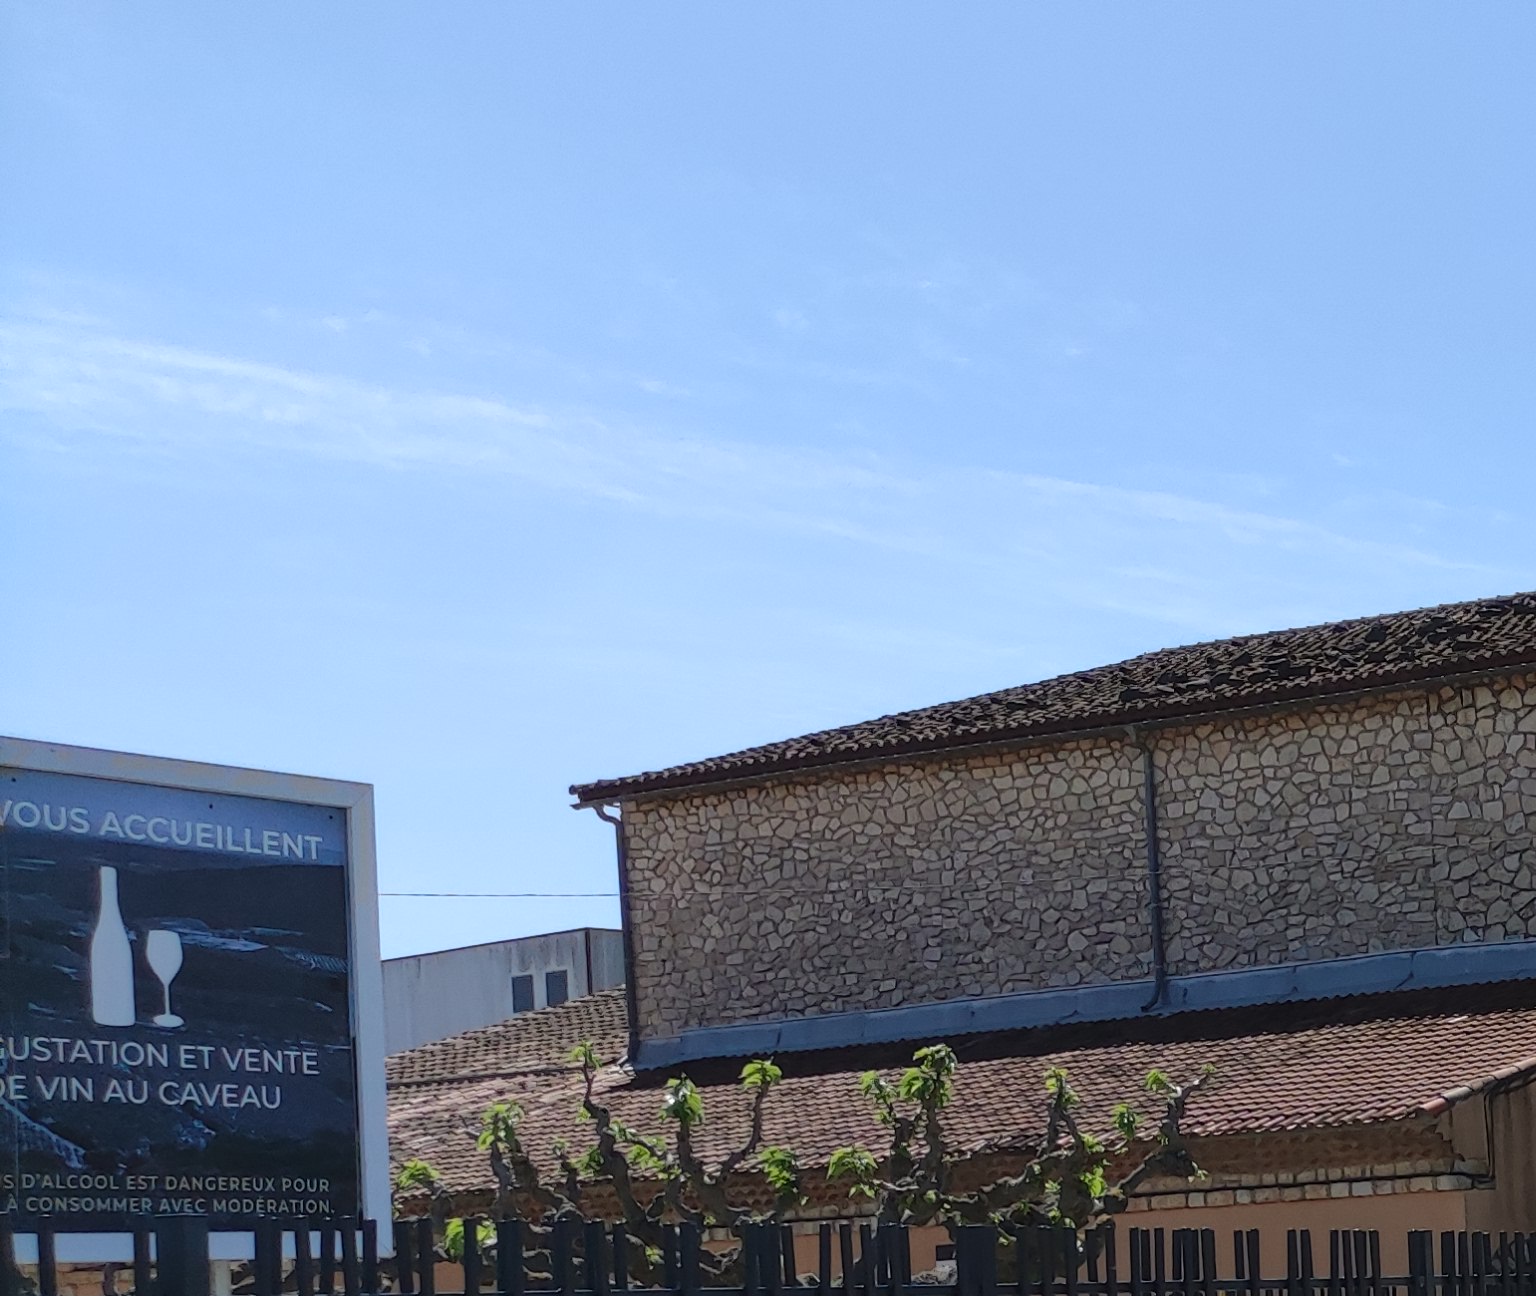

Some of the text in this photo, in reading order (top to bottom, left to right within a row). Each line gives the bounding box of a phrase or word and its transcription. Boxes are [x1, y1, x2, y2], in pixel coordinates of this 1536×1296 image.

[99, 811, 323, 860] ACCUEILLENT
[0, 1036, 320, 1075] USTATION ET VENTE
[0, 1074, 281, 1109] E VIN AU CAVEAU
[21, 1173, 119, 1190] D'ALCOOL
[127, 1175, 159, 1190] EST
[165, 1176, 275, 1192] DANGEREUX
[282, 1177, 329, 1193] POUR
[26, 1197, 151, 1212] CONSOMMER
[159, 1198, 206, 1213] AVEC
